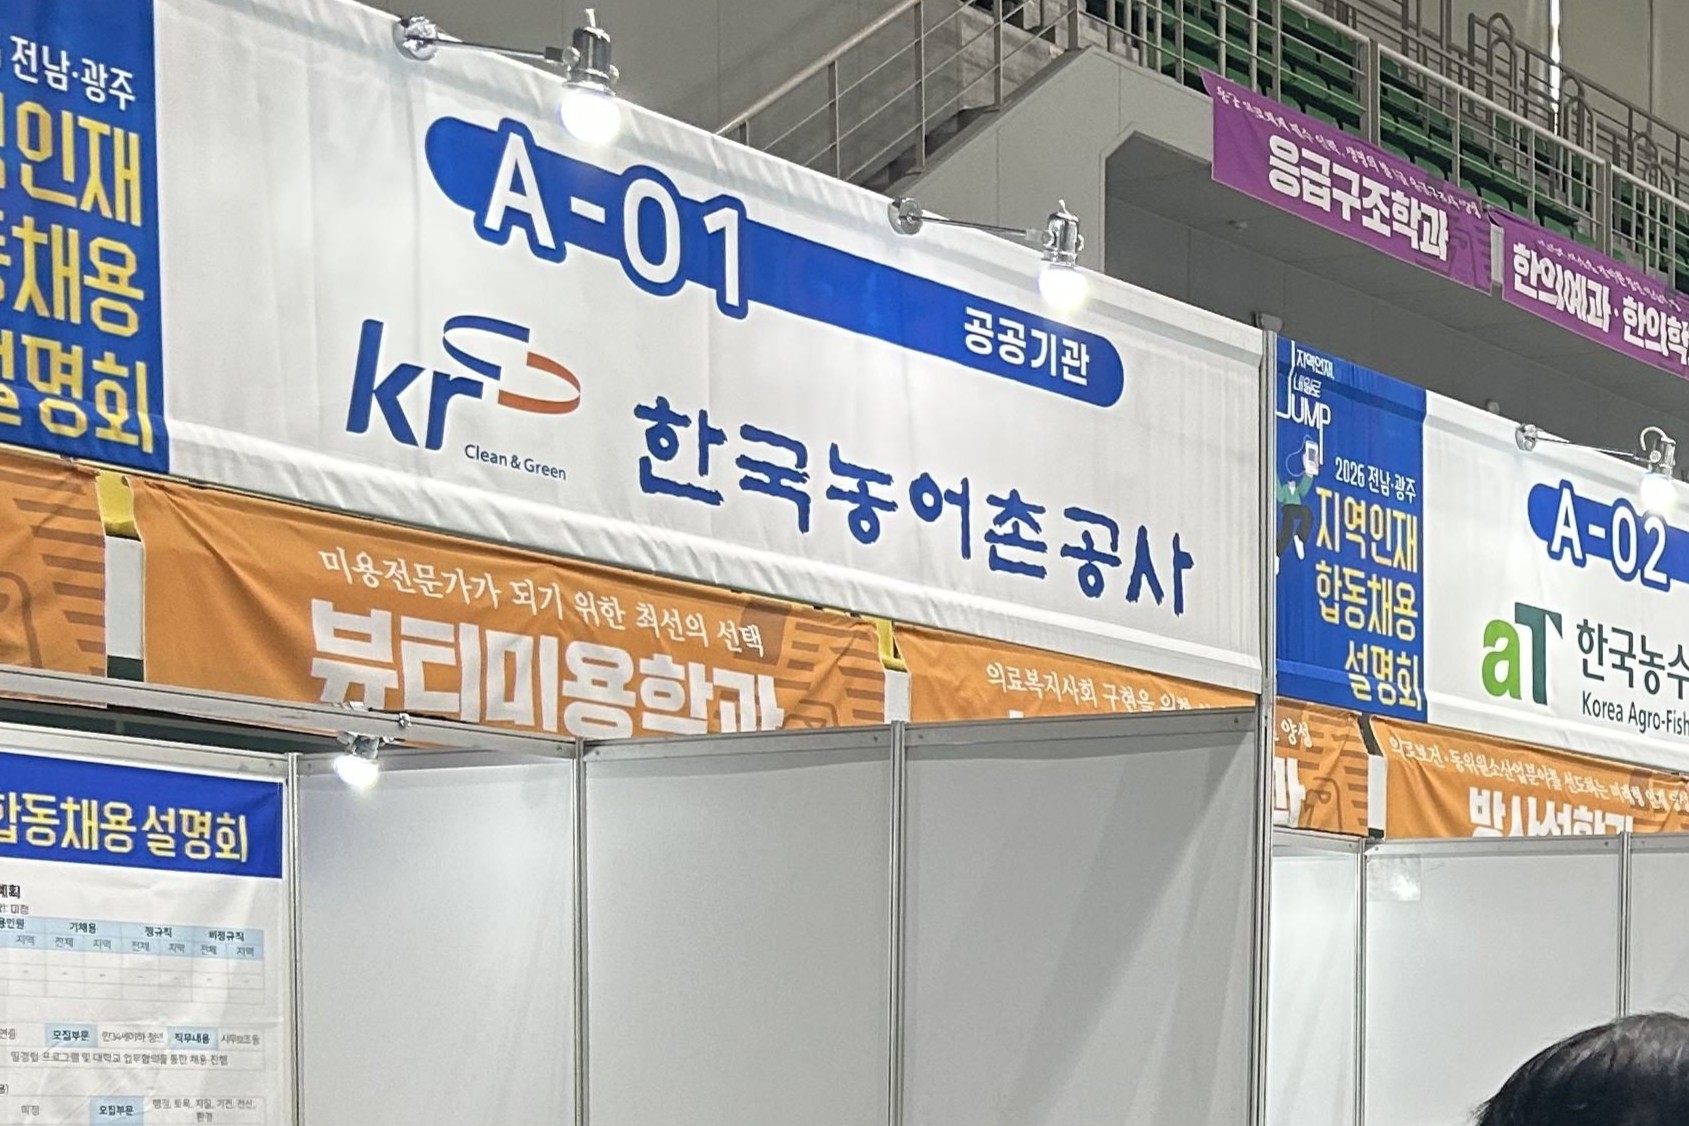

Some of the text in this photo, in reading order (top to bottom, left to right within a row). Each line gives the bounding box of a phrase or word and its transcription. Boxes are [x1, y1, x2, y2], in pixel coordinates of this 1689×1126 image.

[10, 35, 136, 112] 전남·광주
[0, 92, 141, 227] 인재
[484, 132, 740, 307] A-01
[1268, 134, 1449, 261] 응급구조학과
[964, 306, 1090, 388] 공공기관
[1276, 392, 1331, 452] JUMP
[464, 444, 567, 480] Clean & Green
[1335, 457, 1417, 503] 2026 전남·광주
[633, 396, 1195, 617] 한국농어촌공사
[1316, 486, 1418, 573] 지역인재
[1550, 487, 1667, 584] A-02
[318, 547, 765, 658] 미용전문가가 되기 위한 최선의 선택
[1315, 560, 1418, 642] 합동채용
[311, 598, 785, 740] 뷰티미용학과
[986, 661, 1097, 708] 의료복지사회
[1102, 683, 1154, 712] 구현을
[1345, 640, 1422, 711] 설명회
[1482, 601, 1563, 706] aT
[1280, 717, 1312, 748] 양성
[1582, 690, 1623, 722] Korea
[141, 805, 248, 863] 설명회
[15, 935, 35, 946] 지역
[55, 937, 74, 948] 전체
[93, 939, 112, 950] 지역
[132, 941, 150, 952] 전체
[69, 923, 245, 942] 기채용 정규직 비정규직
[53, 1030, 89, 1041] 모집부문
[175, 1032, 210, 1044] 직무내용
[93, 1052, 120, 1063] 대학교
[99, 1105, 134, 1116] 모집부문
